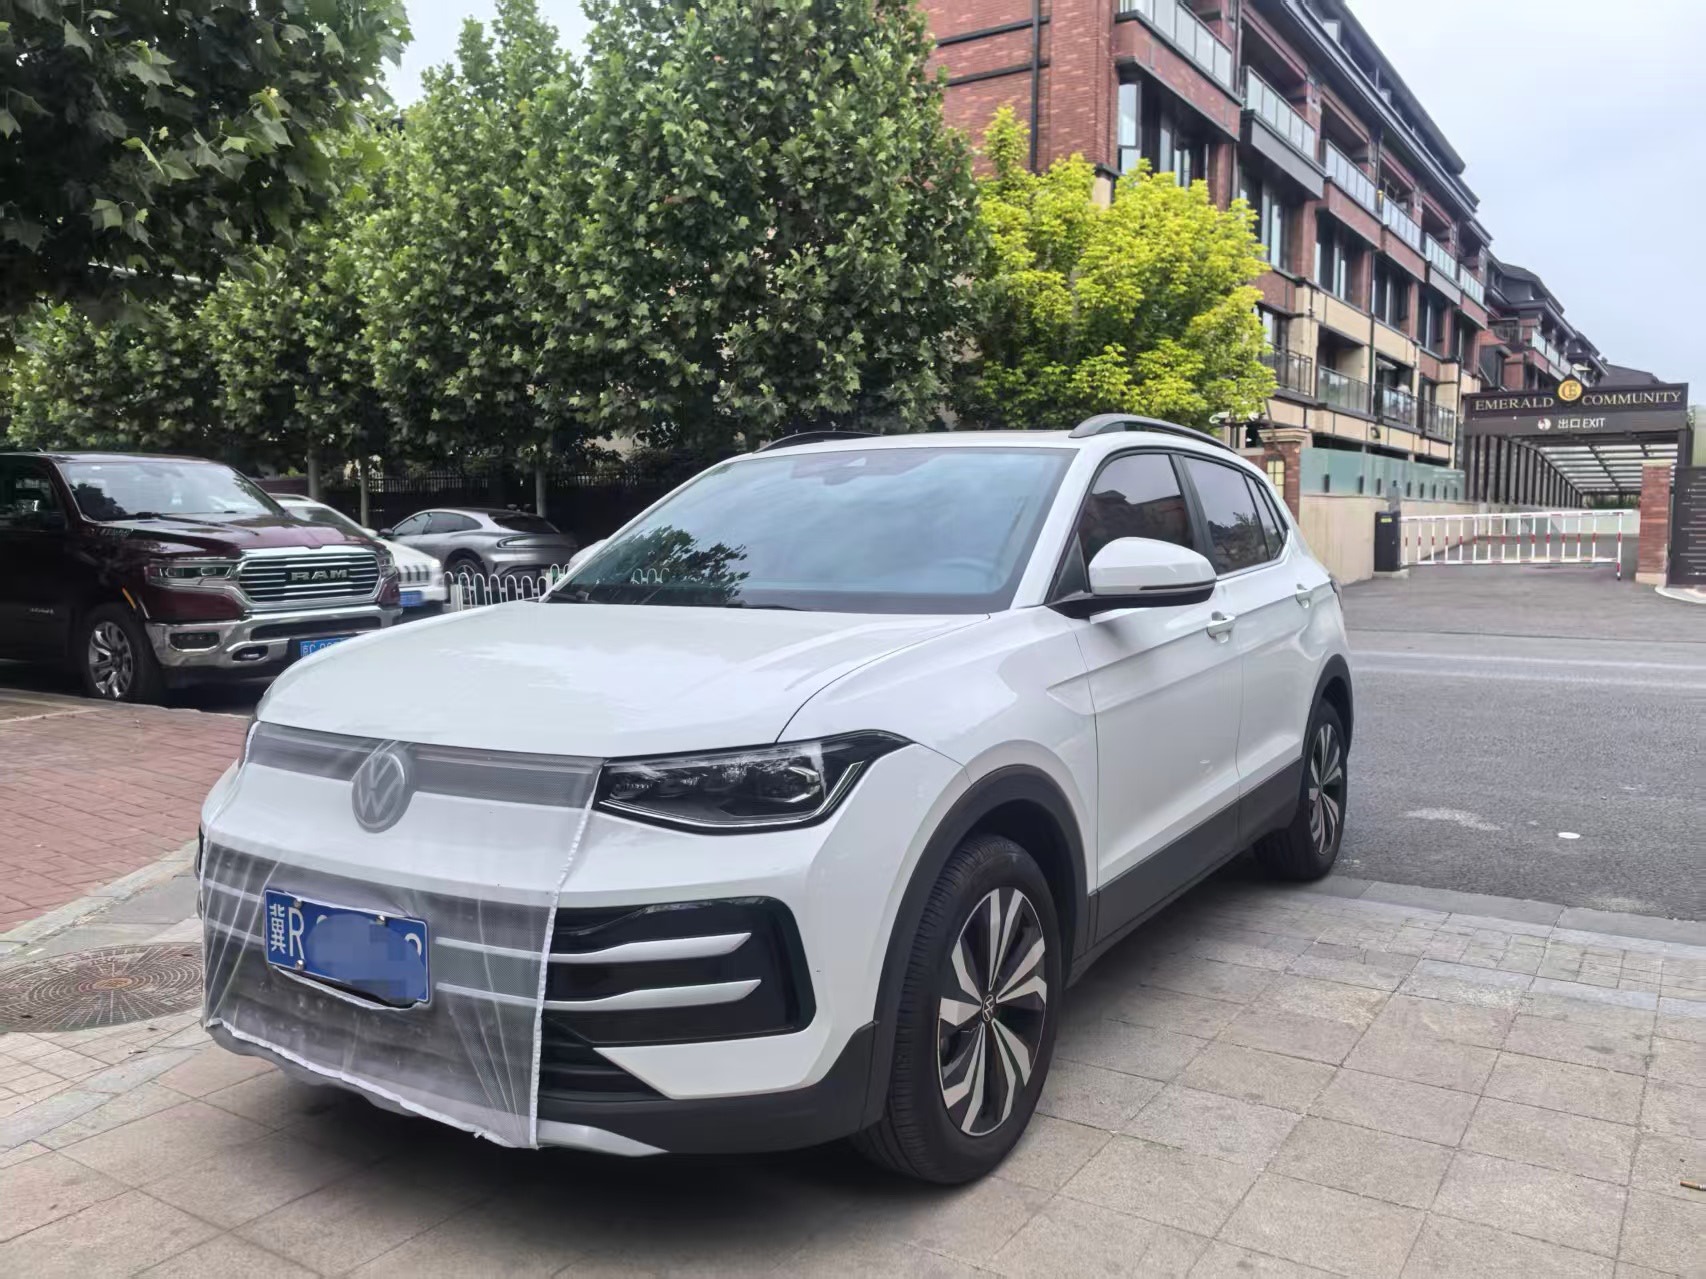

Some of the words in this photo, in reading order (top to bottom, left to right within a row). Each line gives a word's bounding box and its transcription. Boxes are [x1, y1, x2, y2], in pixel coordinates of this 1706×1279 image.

[1475, 397, 1554, 411] EMERALD
[1582, 391, 1681, 405] COMMUNITY
[1558, 418, 1580, 429] 出口
[1582, 417, 1606, 428] EXIT
[291, 569, 349, 581] RAM
